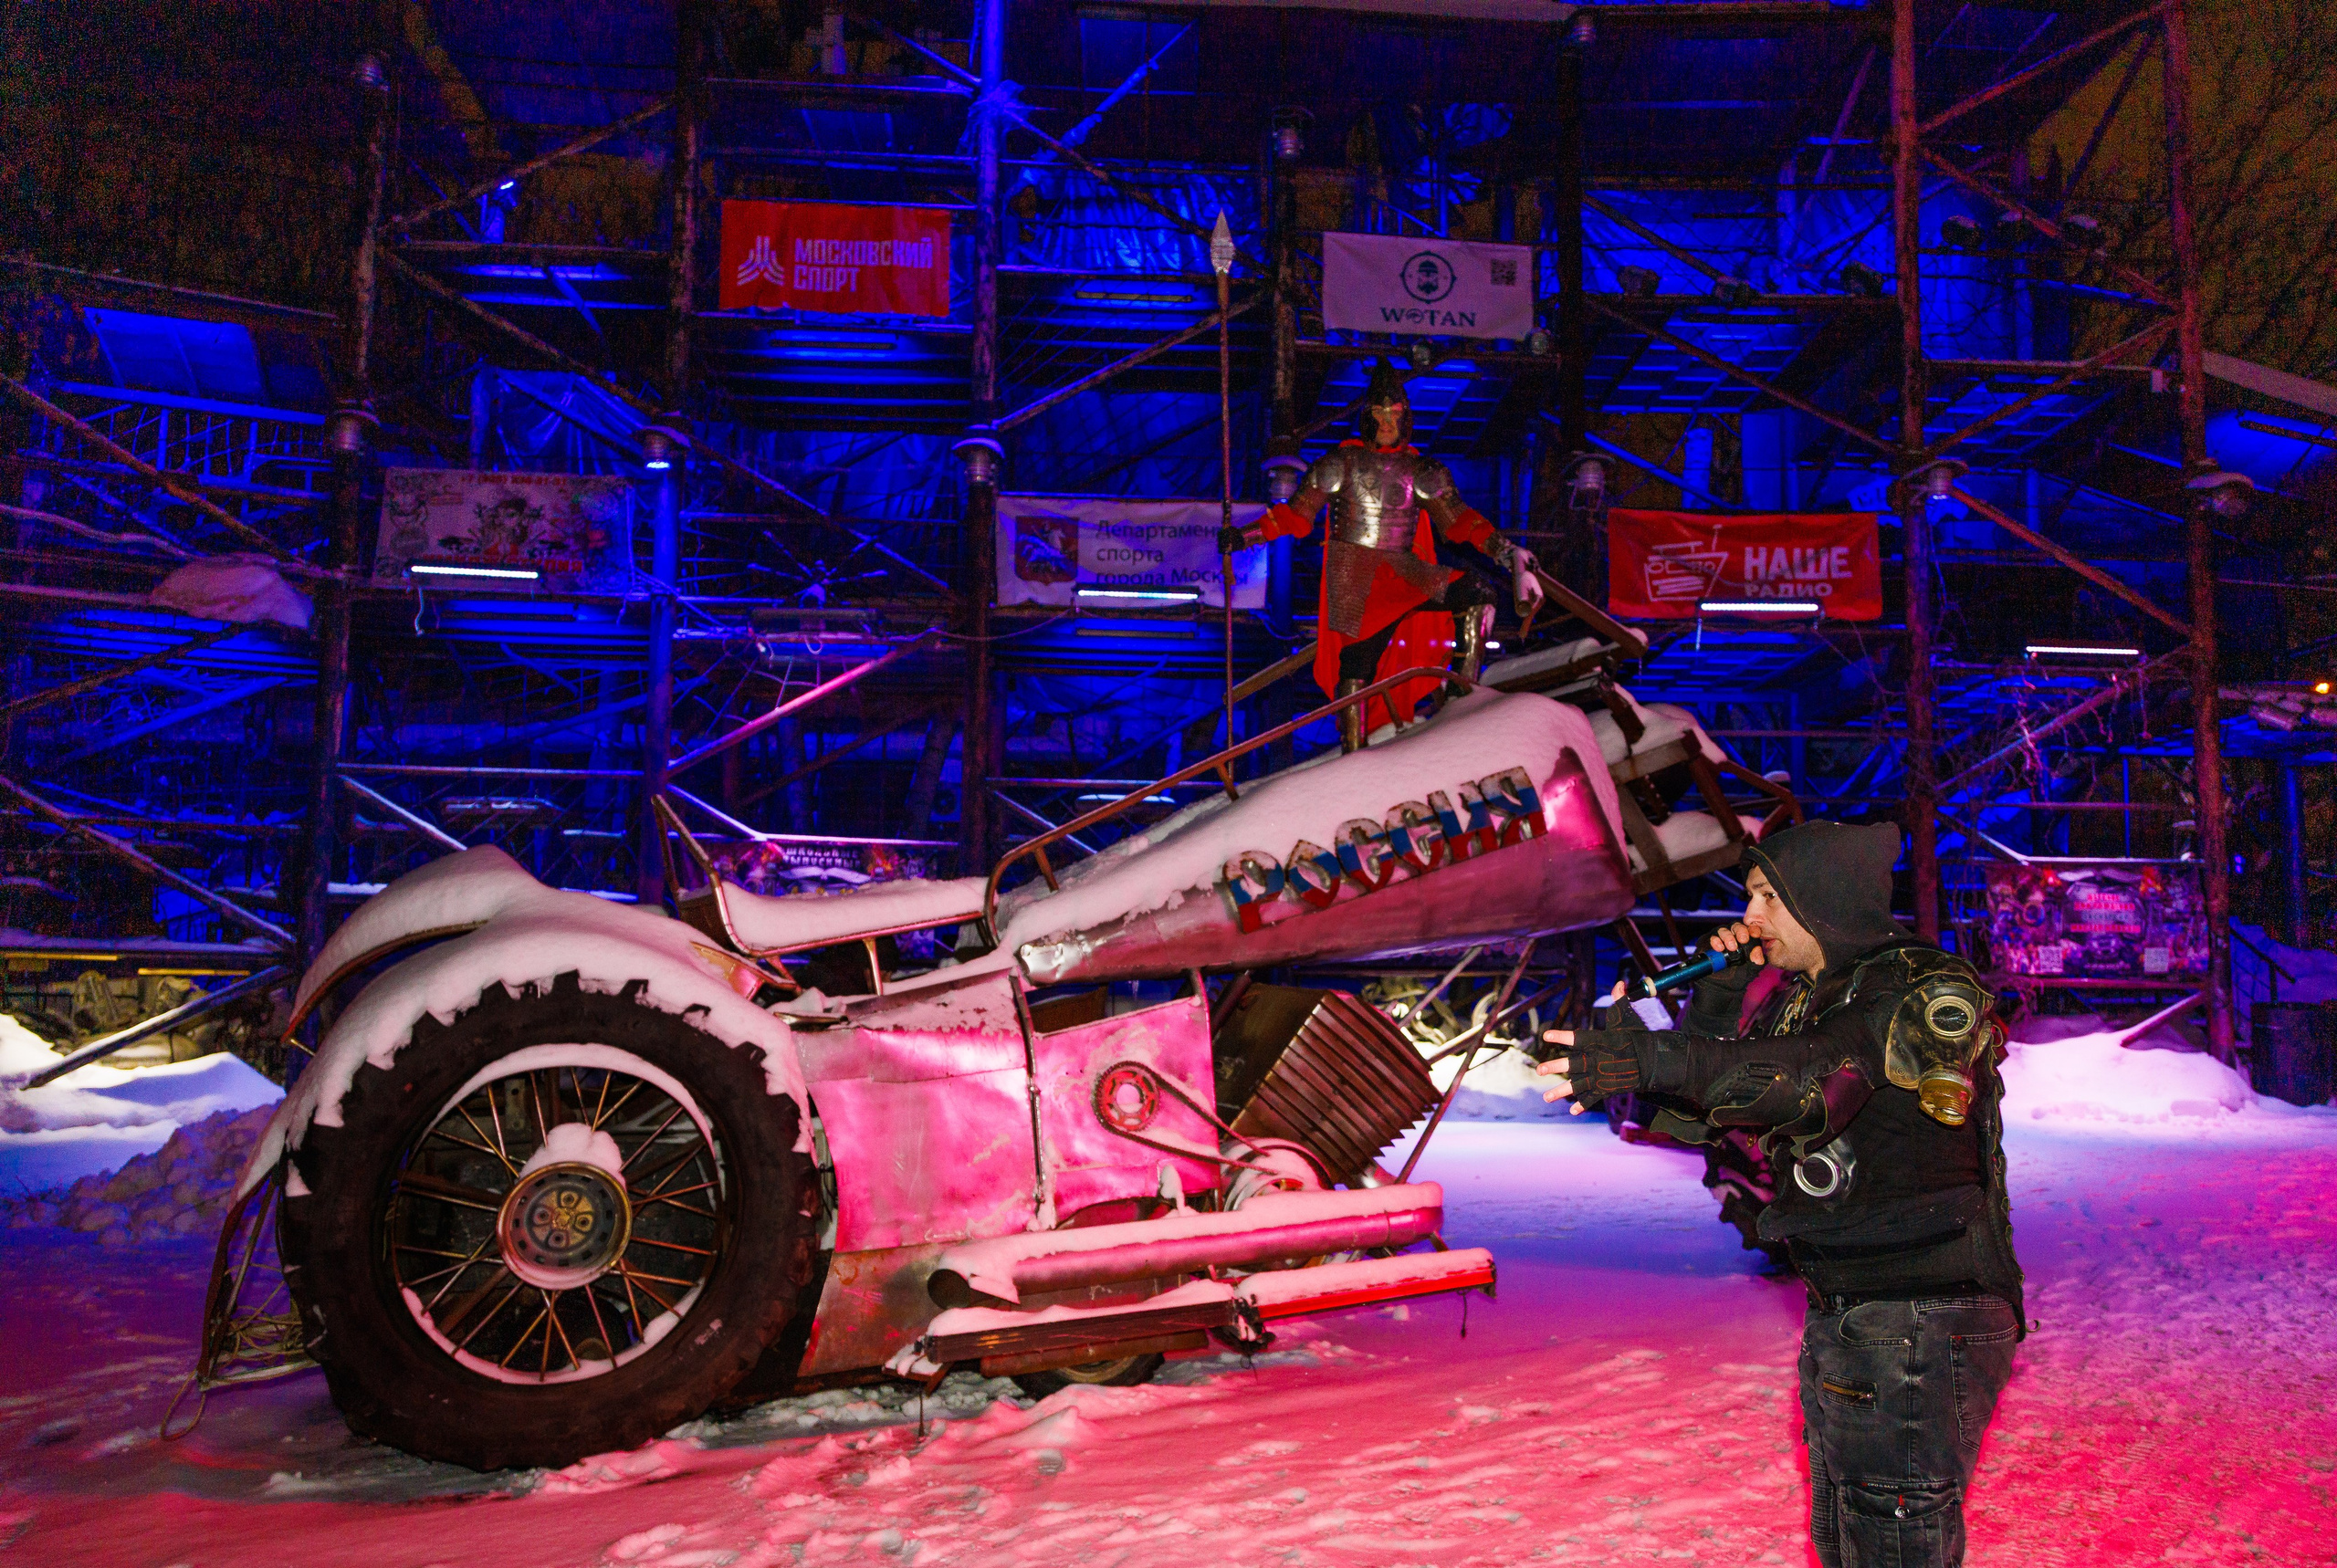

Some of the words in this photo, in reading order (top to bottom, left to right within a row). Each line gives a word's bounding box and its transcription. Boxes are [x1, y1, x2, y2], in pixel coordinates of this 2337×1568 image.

[794, 237, 933, 268] МОСКОВСКИЙ
[793, 265, 860, 292] СПОРТ
[1380, 307, 1476, 327] WOTAN
[1096, 519, 1224, 541] Департамен
[1096, 547, 1164, 565] спорта
[1745, 547, 1852, 580] НАШЕ
[1171, 568, 1248, 584] Москы
[1745, 583, 1833, 598] РАДИО
[1217, 765, 1549, 934] РОССИЯ
